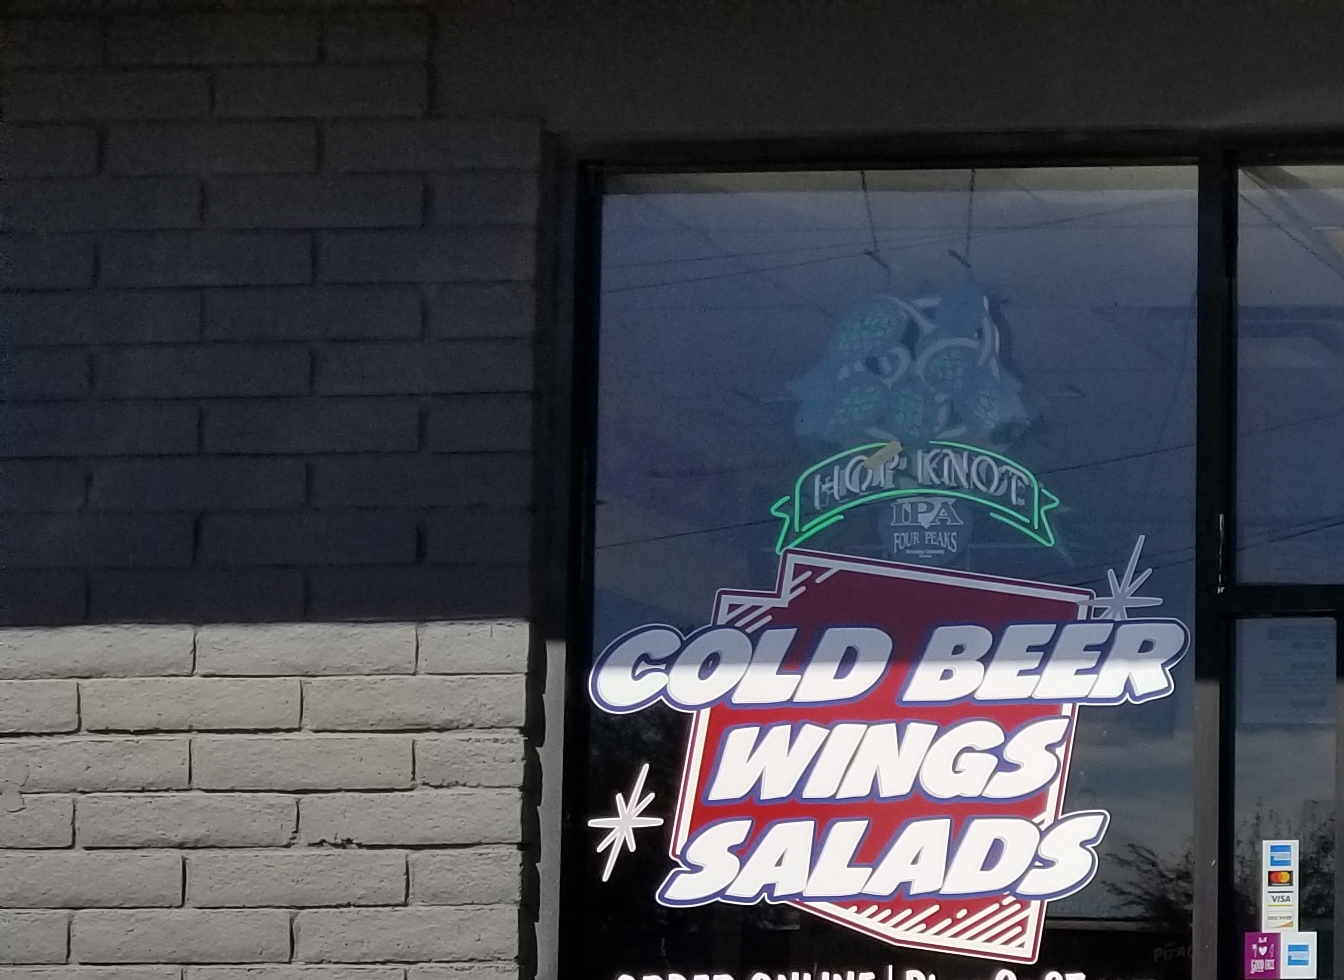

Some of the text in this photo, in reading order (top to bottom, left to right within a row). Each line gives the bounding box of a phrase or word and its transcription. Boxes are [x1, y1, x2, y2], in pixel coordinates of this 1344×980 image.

[814, 449, 1030, 510] HOP KNOT
[890, 497, 964, 529] IPA
[893, 531, 957, 553] FOUR PEAKS
[593, 623, 894, 710] COLD
[900, 621, 1189, 705] BEER
[708, 718, 1069, 801] WINGS
[660, 811, 1109, 903] SALADS
[1271, 895, 1292, 903] VISA
